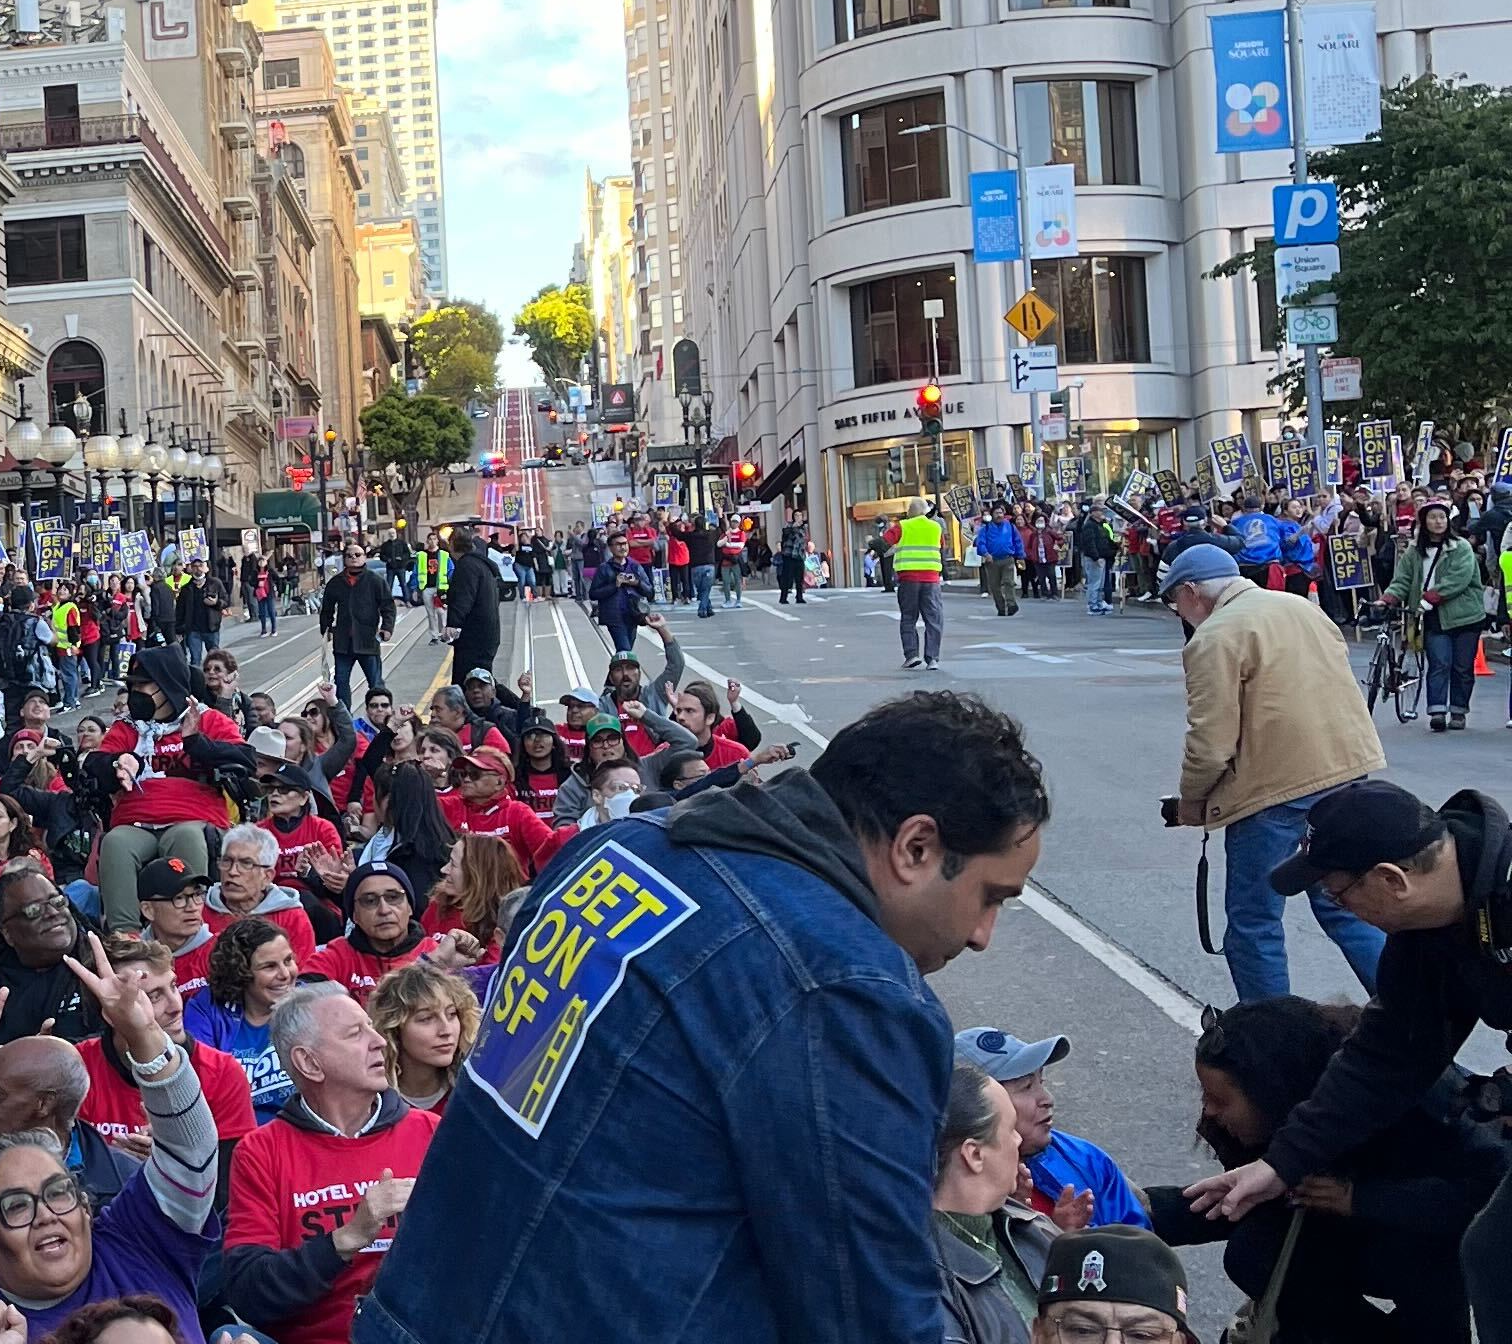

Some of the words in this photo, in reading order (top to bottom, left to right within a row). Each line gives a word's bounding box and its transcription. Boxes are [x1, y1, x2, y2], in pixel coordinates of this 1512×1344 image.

[1317, 40, 1361, 51] SQUARE
[1228, 47, 1270, 58] SQUARE
[1294, 256, 1320, 264] Union
[1294, 263, 1326, 272] Square
[862, 409, 896, 424] FIFTH
[904, 401, 965, 419] AVUE
[1363, 426, 1389, 439] BET
[1213, 436, 1244, 453] BET
[1364, 440, 1386, 454] ON
[1218, 451, 1241, 464] ON
[1289, 451, 1315, 465] BET
[1365, 456, 1384, 468] SF
[1023, 464, 1037, 473] ON
[1062, 469, 1079, 479] ON
[1222, 463, 1239, 476] SF
[1290, 462, 1312, 476] ON
[1022, 472, 1034, 481] SF
[1062, 478, 1076, 488] SF
[657, 484, 672, 493] ON
[1292, 477, 1310, 490] SF
[34, 519, 59, 532] BET
[42, 535, 71, 548] BET
[94, 531, 117, 543] BET
[120, 534, 144, 547] BET
[182, 530, 202, 540] BET
[183, 540, 200, 548] ON
[1332, 538, 1354, 551] BE
[42, 547, 64, 559] ON
[123, 545, 143, 557] ON
[94, 554, 109, 566] SF
[125, 557, 142, 568] SF
[1334, 551, 1359, 565] ON
[40, 560, 59, 572] SF
[1336, 565, 1356, 579] SF
[561, 858, 668, 939] BET
[525, 909, 597, 990] ON
[493, 965, 549, 1036] SF
[293, 1183, 353, 1209] HOTEL
